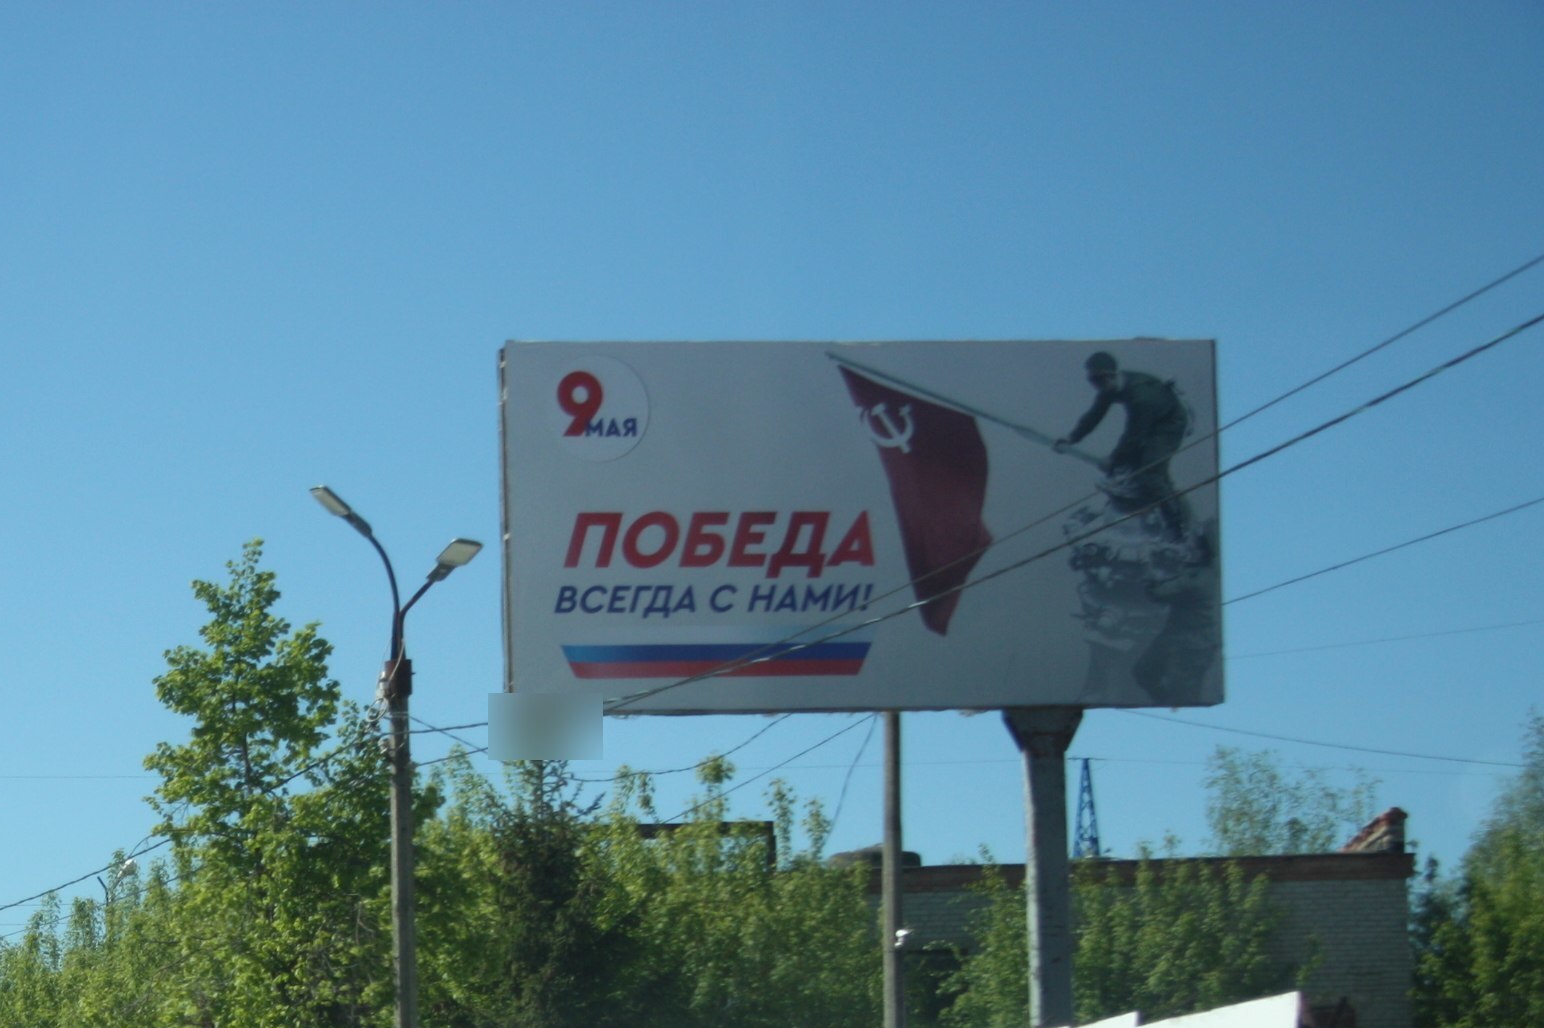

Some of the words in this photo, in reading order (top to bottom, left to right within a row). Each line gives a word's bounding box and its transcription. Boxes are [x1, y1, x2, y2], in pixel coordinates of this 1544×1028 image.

[557, 370, 603, 437] 9
[584, 417, 638, 438] МАЯ
[563, 510, 876, 579] ПОБЕДА
[554, 584, 696, 618] ВСЕГДА
[709, 584, 738, 613] С
[747, 583, 873, 613] НАМИ!
